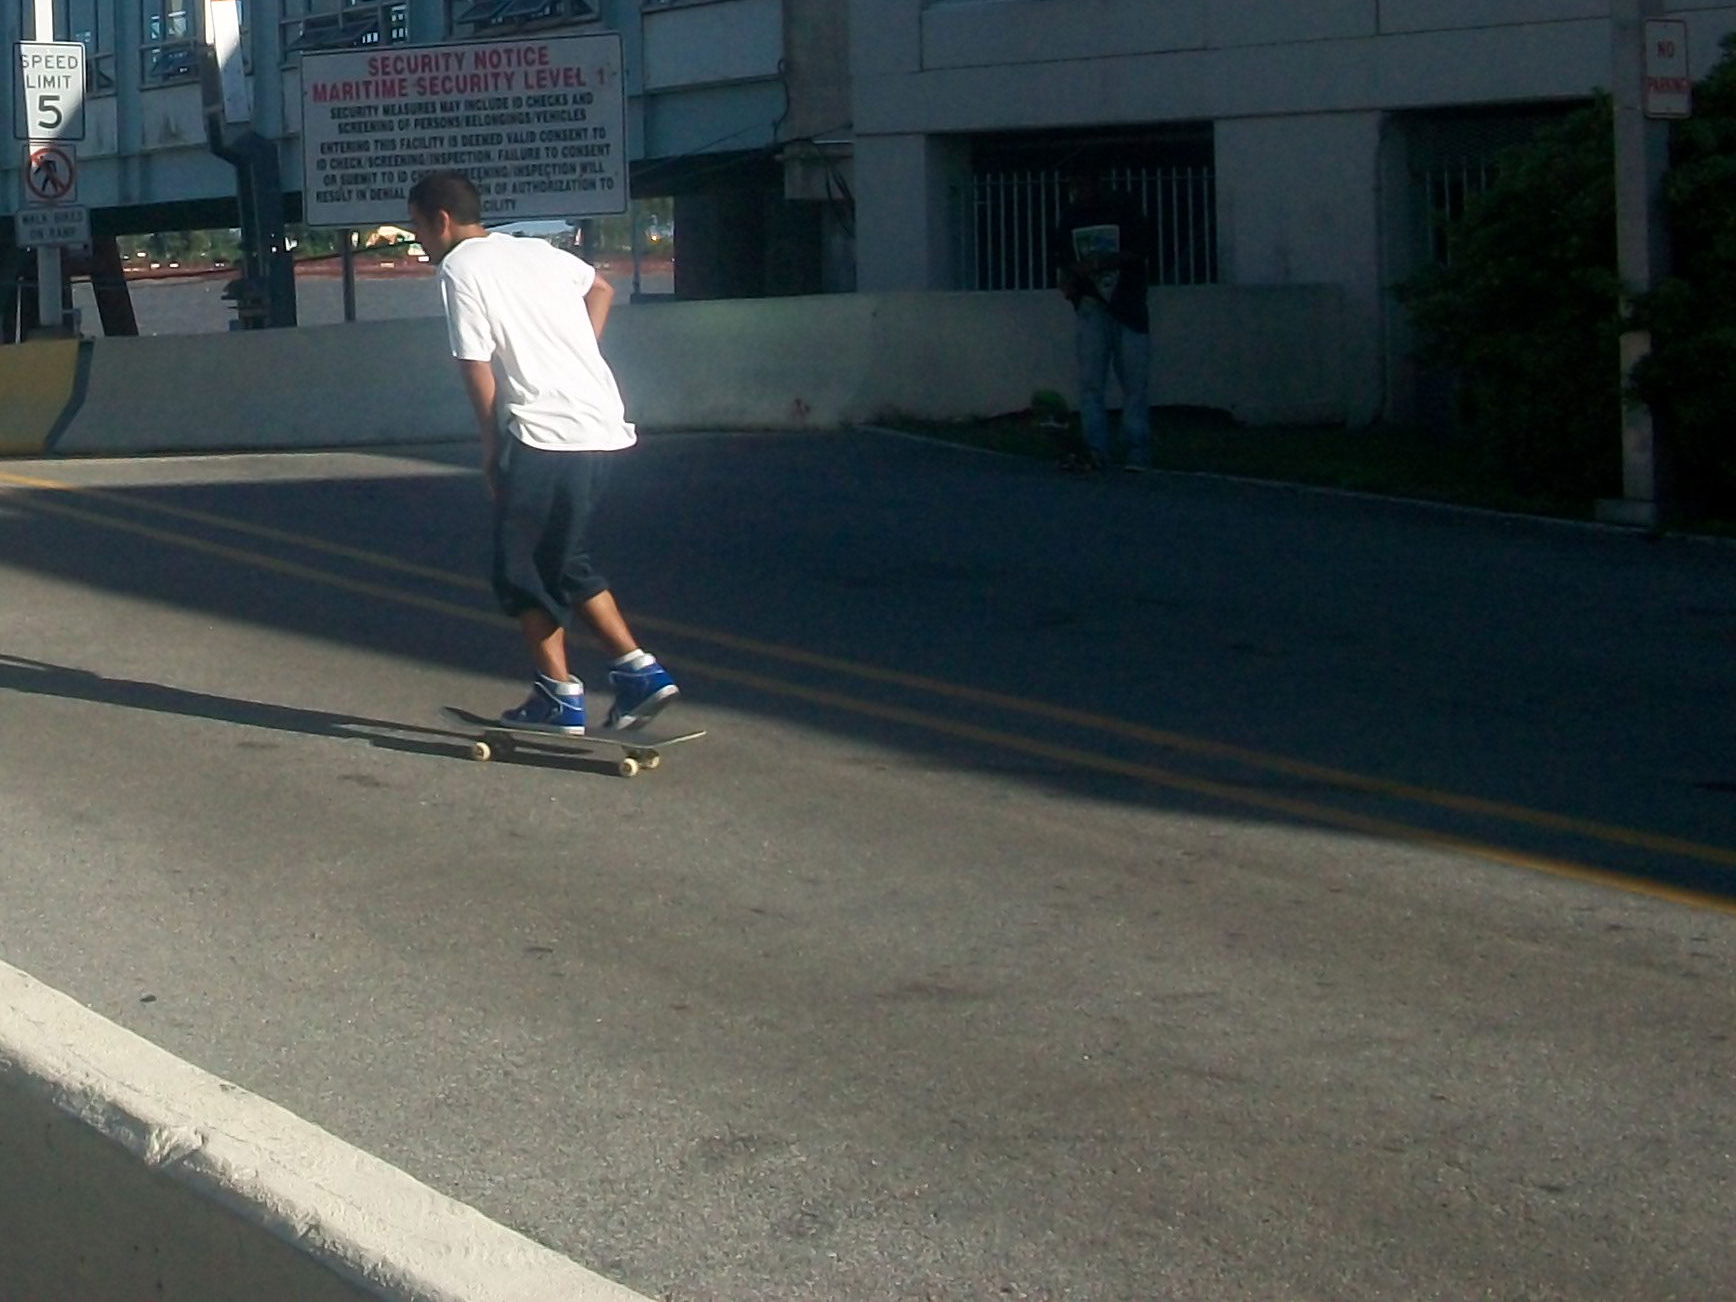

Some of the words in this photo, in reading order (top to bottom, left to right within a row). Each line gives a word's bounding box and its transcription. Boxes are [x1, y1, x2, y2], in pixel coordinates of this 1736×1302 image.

[367, 50, 465, 77] SECURITY
[474, 46, 550, 71] NOTICE
[1657, 39, 1675, 58] NO
[21, 54, 79, 71] SPEED
[25, 74, 72, 90] LIMIT
[312, 76, 408, 103] MARITIME
[415, 70, 516, 97] SECURITY
[524, 65, 587, 90] LEVEL
[596, 68, 606, 86] 1
[38, 94, 63, 129] 5
[330, 105, 379, 120] SECURITY
[382, 101, 437, 116] MEASURES
[440, 100, 461, 113] MAY
[464, 96, 509, 111] INCLUDE
[512, 96, 523, 109] ID
[525, 93, 569, 108] CHECKS
[572, 91, 594, 105] AND
[320, 140, 370, 155] ENTERING
[374, 138, 396, 151] THIS
[399, 136, 446, 150] FACILITY
[448, 135, 458, 147] IS
[461, 132, 504, 147] DEEMED
[506, 130, 537, 144] VALID
[539, 127, 588, 142] CONSENT
[592, 126, 607, 139] TO
[337, 119, 395, 135] SCREENING
[398, 119, 410, 131] OF
[316, 158, 327, 171] ID
[497, 146, 541, 161] FAILURE
[545, 145, 558, 159] TO
[561, 143, 611, 158] CONSENT
[323, 174, 338, 187] OR
[340, 171, 377, 186] SUBMIT
[380, 170, 395, 184] TO
[398, 170, 408, 183] ID
[580, 160, 605, 175] WILL
[316, 189, 354, 203] RESULT
[356, 189, 367, 201] IN
[370, 187, 406, 201] DENIAL
[494, 182, 507, 195] OF
[511, 179, 597, 195] AUTHORIZATION
[600, 178, 615, 191] TO
[483, 198, 517, 212] CILITY
